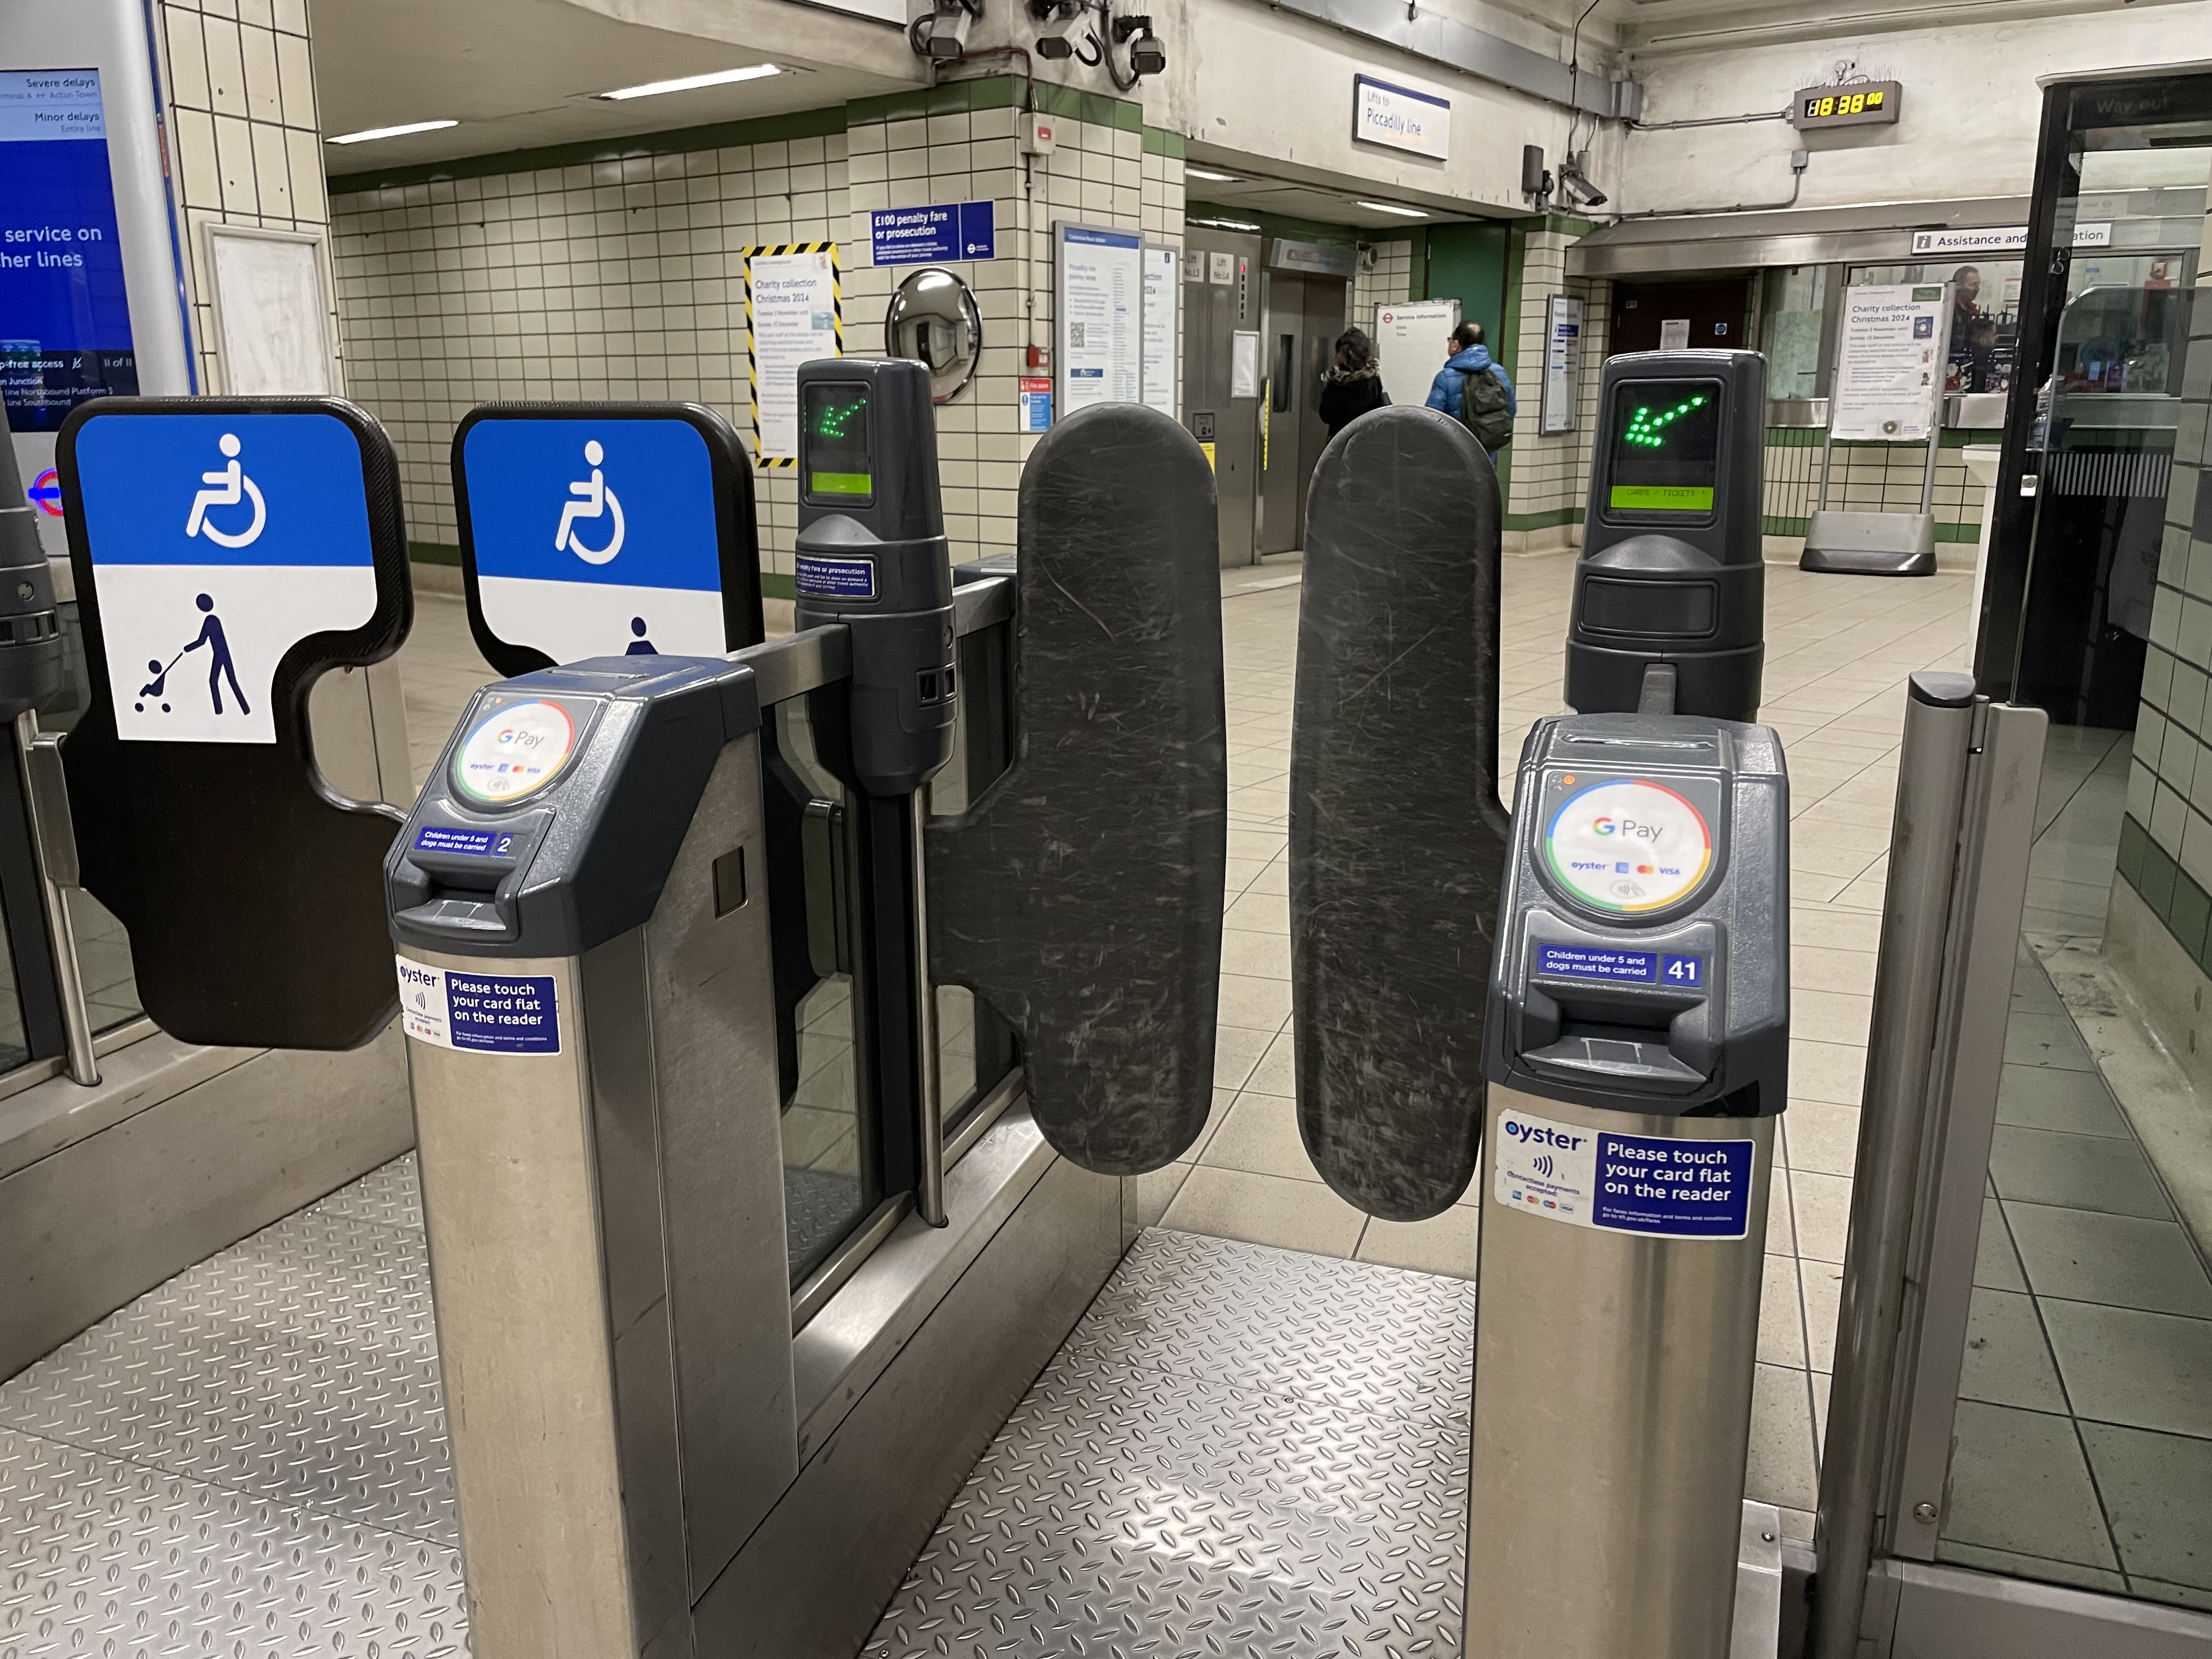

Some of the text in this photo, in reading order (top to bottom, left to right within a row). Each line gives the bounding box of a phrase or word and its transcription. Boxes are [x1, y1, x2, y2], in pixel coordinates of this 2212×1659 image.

[26, 77, 95, 88] Severe delays
[1367, 91, 1389, 106] Lifts to
[1866, 91, 1883, 105] 00
[35, 112, 99, 122] Minor delays
[1367, 108, 1421, 136] Piccadilly line
[874, 211, 948, 227] £100 penalty fare
[5, 226, 102, 242] service on
[875, 225, 936, 241] or prosecution
[1937, 230, 2103, 246] Assistance and ation
[0, 251, 83, 268] her lines
[755, 278, 817, 290] Charity collection
[757, 293, 810, 303] Christmas 2024
[1882, 303, 1920, 312] collection
[32, 360, 64, 368] access
[112, 357, 123, 367] of
[498, 729, 544, 749] G Pay
[425, 831, 450, 839] Children
[1593, 817, 1663, 843] G Pay
[497, 837, 511, 852] 2
[1571, 862, 1606, 870] oyster
[1547, 950, 1586, 961] Children
[1588, 955, 1616, 963] under
[1627, 957, 1645, 965] and
[1547, 961, 1570, 971] dogs
[1613, 967, 1647, 975] carried
[1668, 961, 1696, 980] 41
[400, 965, 437, 988] oyster
[451, 978, 535, 995] Please touch
[453, 995, 541, 1011] your card flat
[454, 1012, 470, 1021] on
[473, 1012, 495, 1024] the
[499, 1013, 543, 1025] reader
[1505, 1121, 1582, 1151] oyster
[1607, 1142, 1727, 1164] Please touch
[1606, 1163, 1731, 1182] your card flat
[1507, 1171, 1580, 1195] Contactless payments
[1605, 1182, 1731, 1201] on the reader
